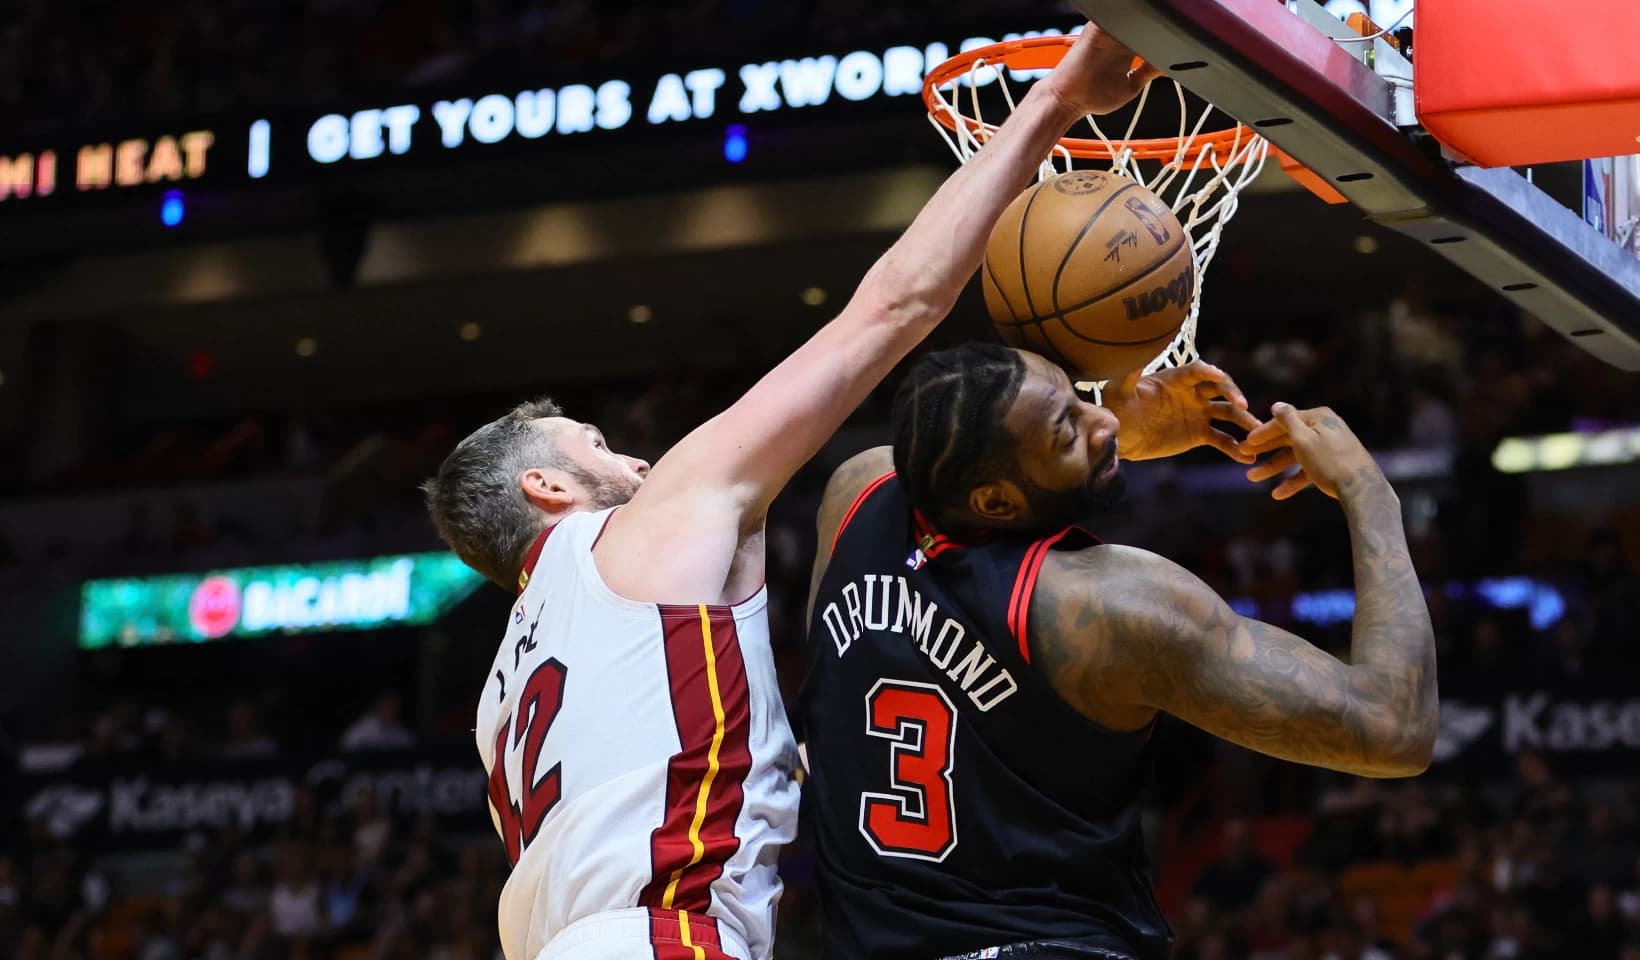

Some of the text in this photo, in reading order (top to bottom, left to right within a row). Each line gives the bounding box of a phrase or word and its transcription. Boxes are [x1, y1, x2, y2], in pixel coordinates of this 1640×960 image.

[76, 130, 214, 191] HEAT
[307, 104, 420, 164] GET
[432, 80, 632, 148] YOURS
[648, 68, 726, 125] AT
[859, 677, 957, 863] 3
